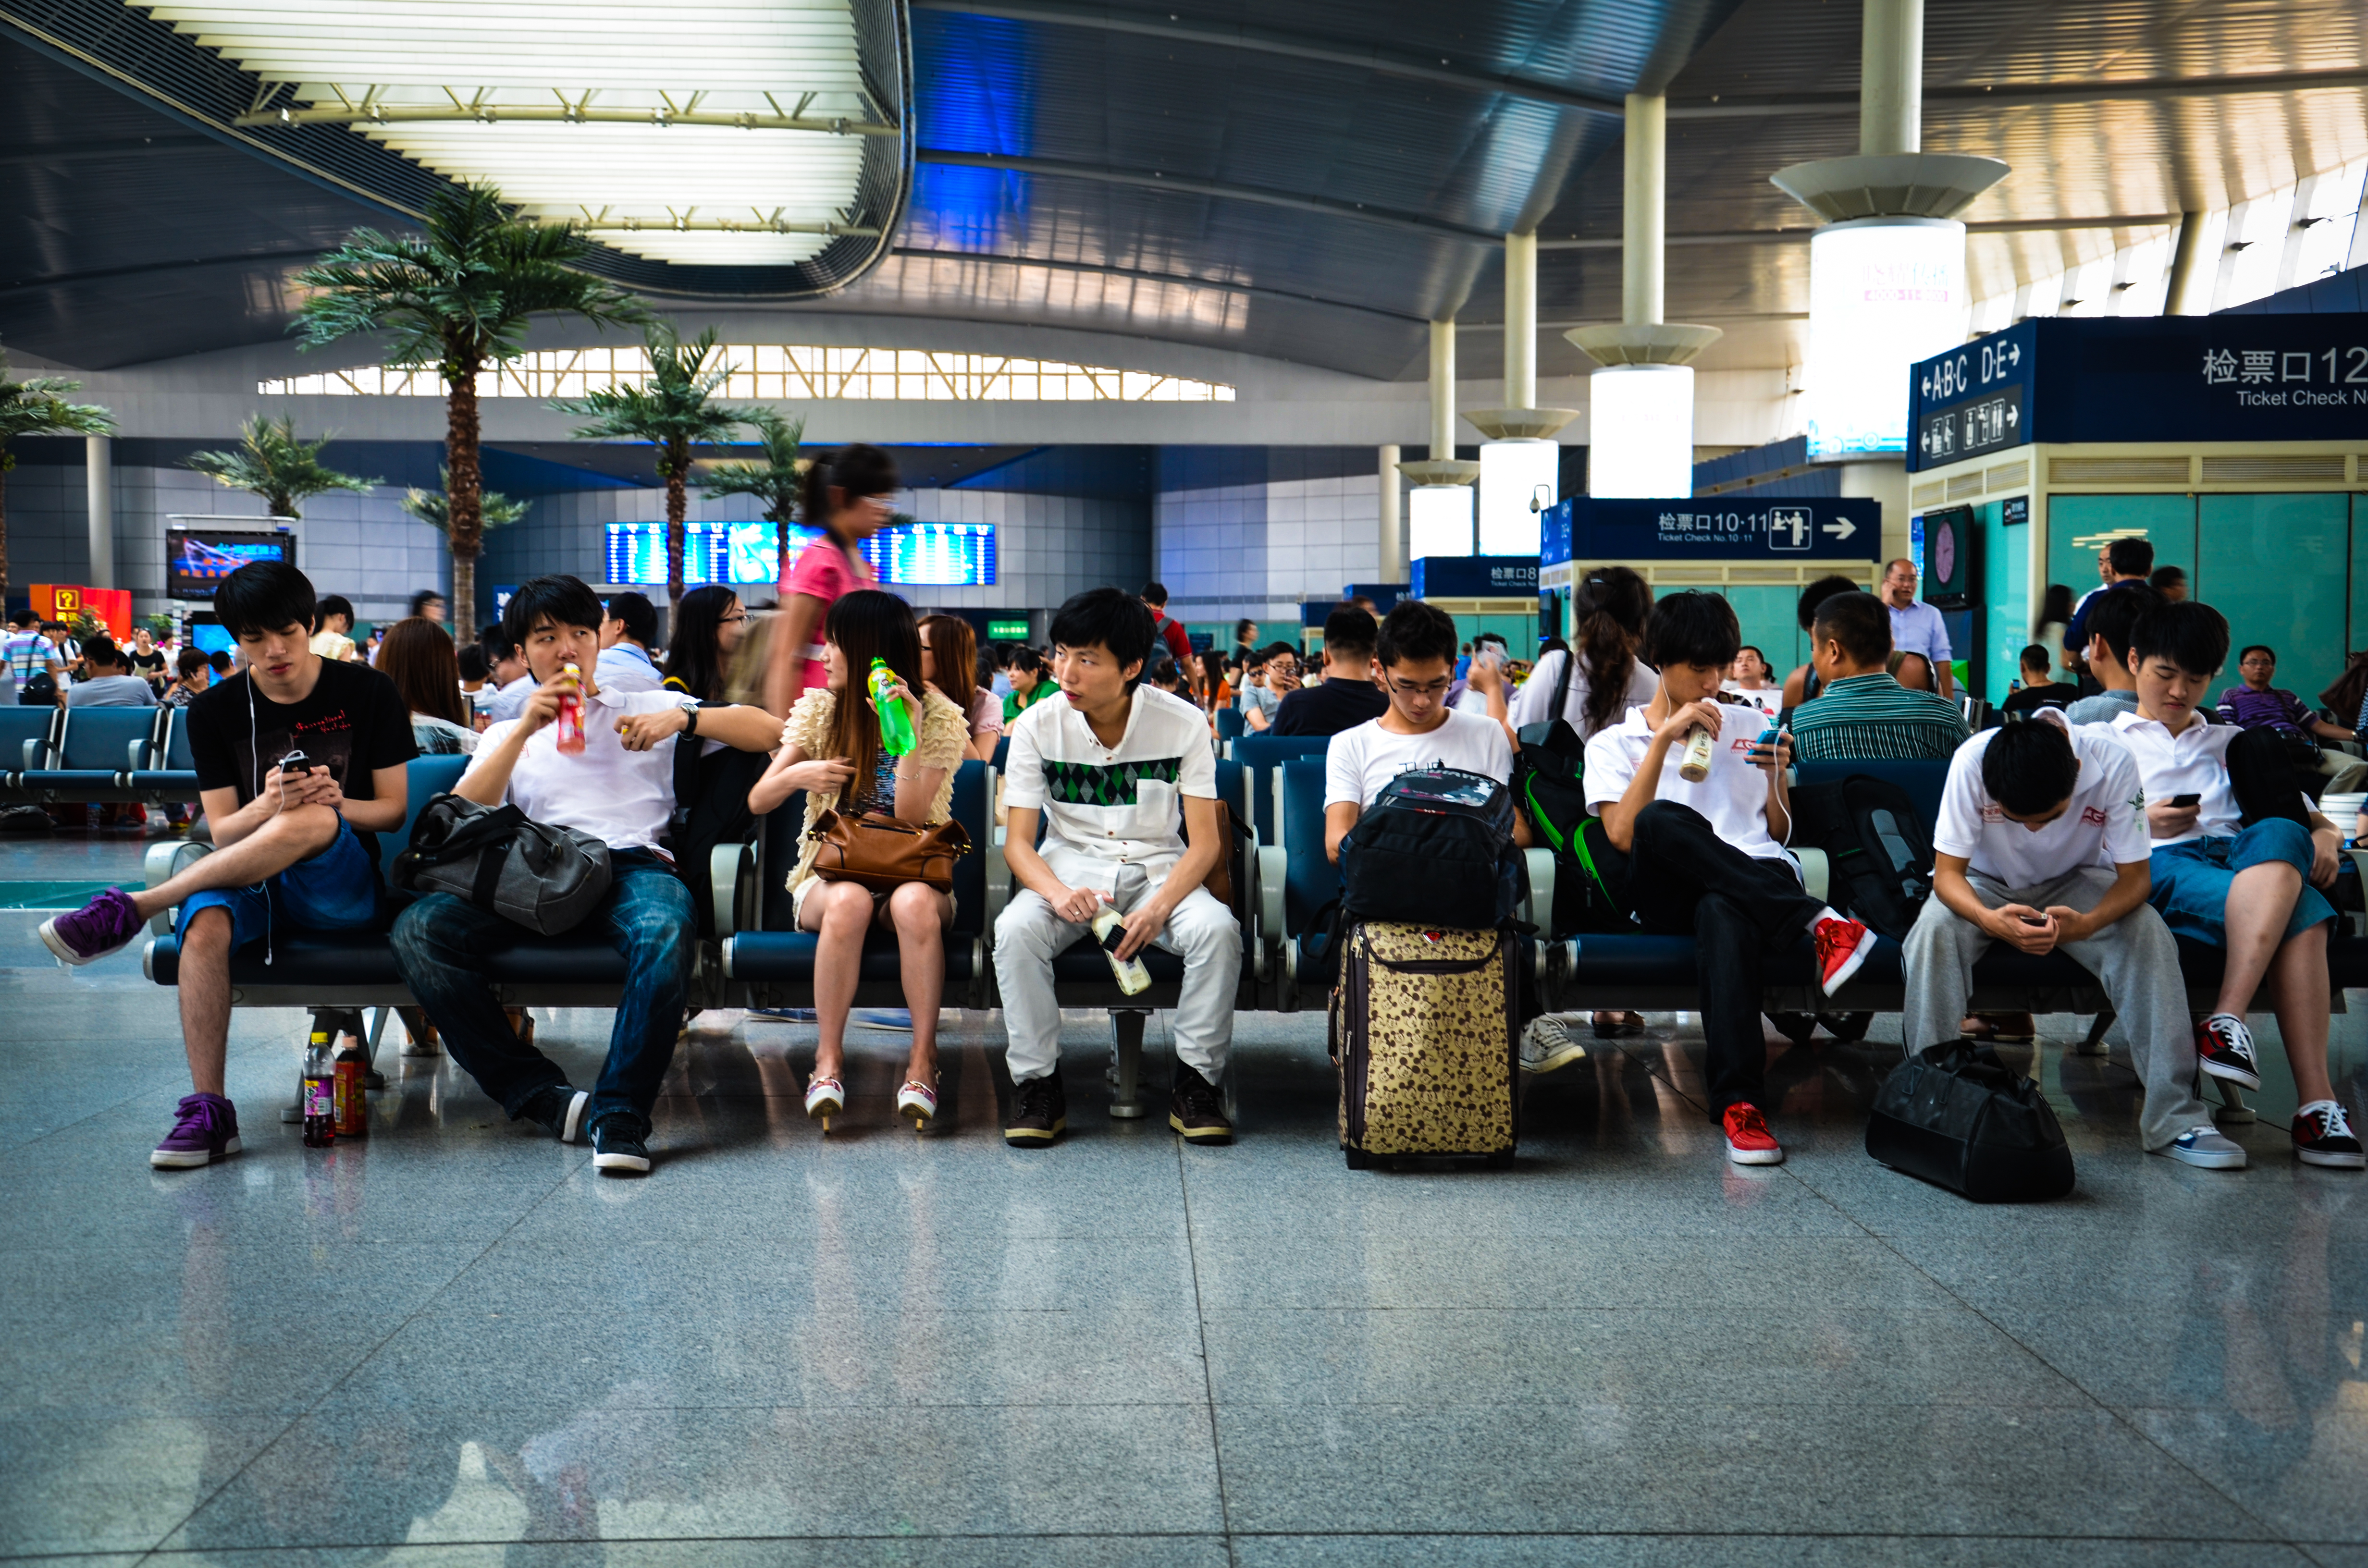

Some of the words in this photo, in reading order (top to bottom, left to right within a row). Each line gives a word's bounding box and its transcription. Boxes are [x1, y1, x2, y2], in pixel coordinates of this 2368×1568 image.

[2236, 391, 2287, 406] Ticket
[2293, 389, 2348, 405] Check
[2353, 389, 2368, 404] N
[1658, 533, 1683, 542] Ticket
[1684, 533, 1711, 542] Check
